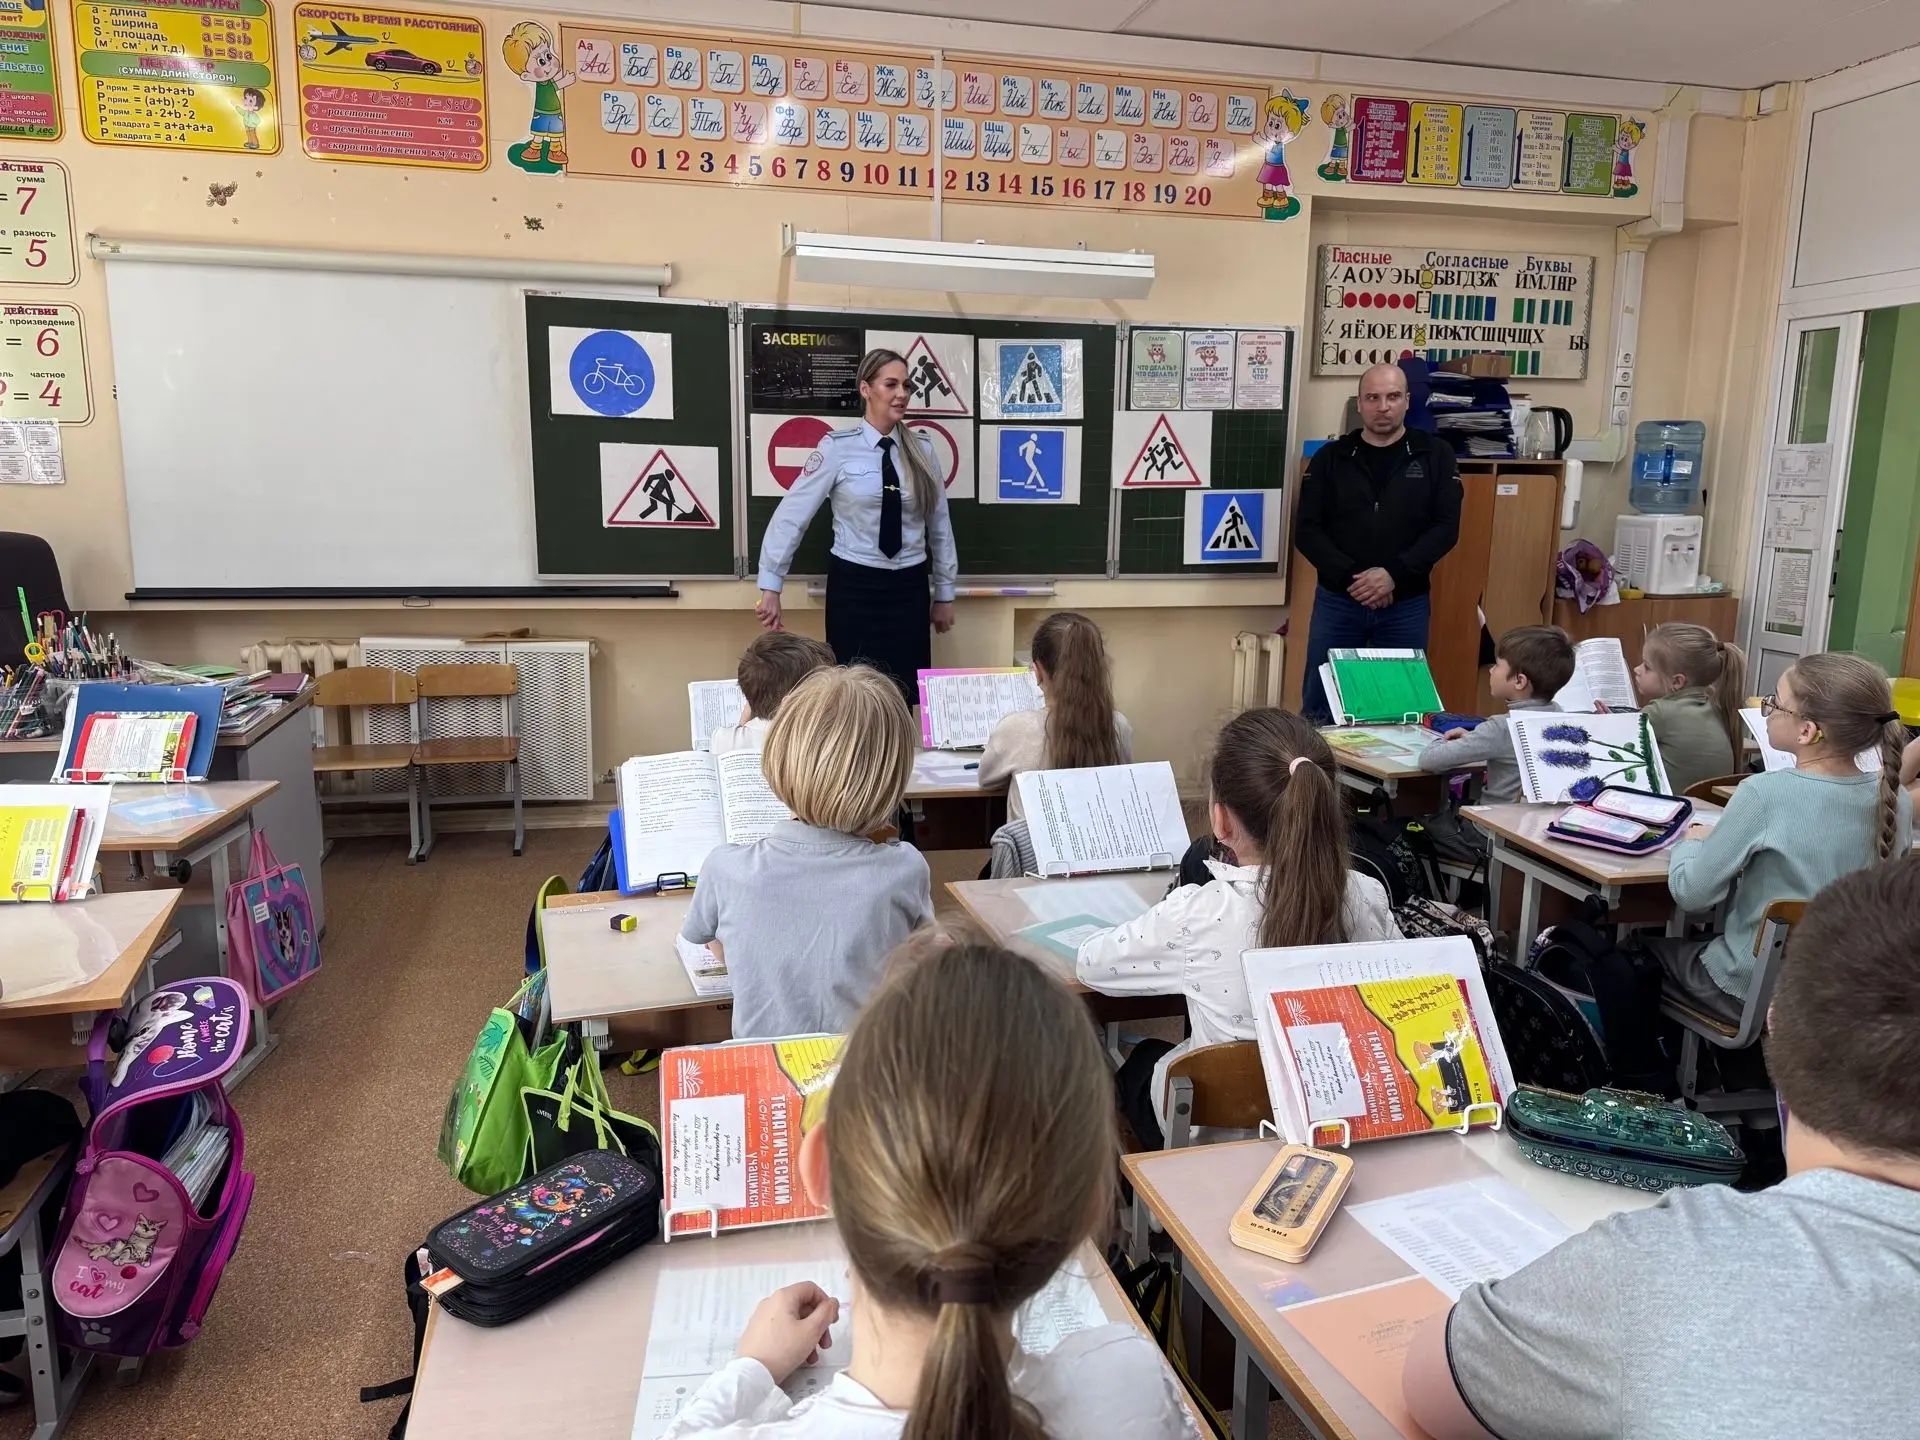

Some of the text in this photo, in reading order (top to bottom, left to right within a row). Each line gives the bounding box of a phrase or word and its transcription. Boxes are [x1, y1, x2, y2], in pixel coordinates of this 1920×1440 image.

[109, 7, 148, 18] длина
[299, 7, 480, 33] СКОРОСТЬ ВРЕМЯ РАССТОЯНИЕ
[111, 19, 159, 30] ширина
[112, 30, 168, 43] площадь
[160, 69, 190, 79] ДЛИН
[577, 39, 1241, 106] Аа Бб Вв Гг Дд Ее Ёё Жж Зз Ии Йй Кк Лл Мм Нн Оо Пп
[328, 108, 388, 119] расстояние
[603, 92, 619, 104] Рр
[647, 95, 662, 106] Сс
[691, 98, 704, 109] Тт
[733, 101, 747, 114] Уу
[775, 105, 795, 117] Фф
[816, 108, 830, 120] Хх
[857, 111, 873, 124] Цц
[897, 115, 912, 126] Чч
[944, 118, 964, 129] Шш
[984, 121, 1004, 134] Щщ
[1133, 134, 1147, 144] Ээ
[1170, 136, 1189, 147] Юю
[1206, 139, 1219, 150] Яя
[112, 120, 150, 130] квадрата
[328, 125, 361, 135] время
[361, 126, 413, 138] движения
[113, 132, 152, 141] квадрата
[328, 142, 374, 153] скорость
[376, 145, 428, 156] движения
[16, 175, 46, 184] сумма
[630, 146, 1212, 207] 0 1 2 3 4 5 6 7 8 9 10 11 12 13 14 15 16 17 18 19 20
[16, 186, 37, 215] 7
[13, 229, 57, 238] разность
[25, 238, 48, 268] 5
[1332, 247, 1572, 274] Гласные Согласные Буквы
[3, 305, 59, 316] ДЕЙСТВИЯ
[9, 318, 75, 327] произведение
[36, 327, 60, 357] 6
[30, 371, 66, 379] частное
[38, 379, 63, 407] 4
[209, 1012, 233, 1038] cat
[177, 1022, 199, 1059] Home
[209, 1038, 226, 1053] the
[1366, 1030, 1405, 1122] ТЕМАТИЧЕСКИЙ
[770, 1094, 792, 1205] ТЕМАТИЧЕСКИЙ
[75, 1265, 126, 1295] I my
[69, 1280, 106, 1299] cat
